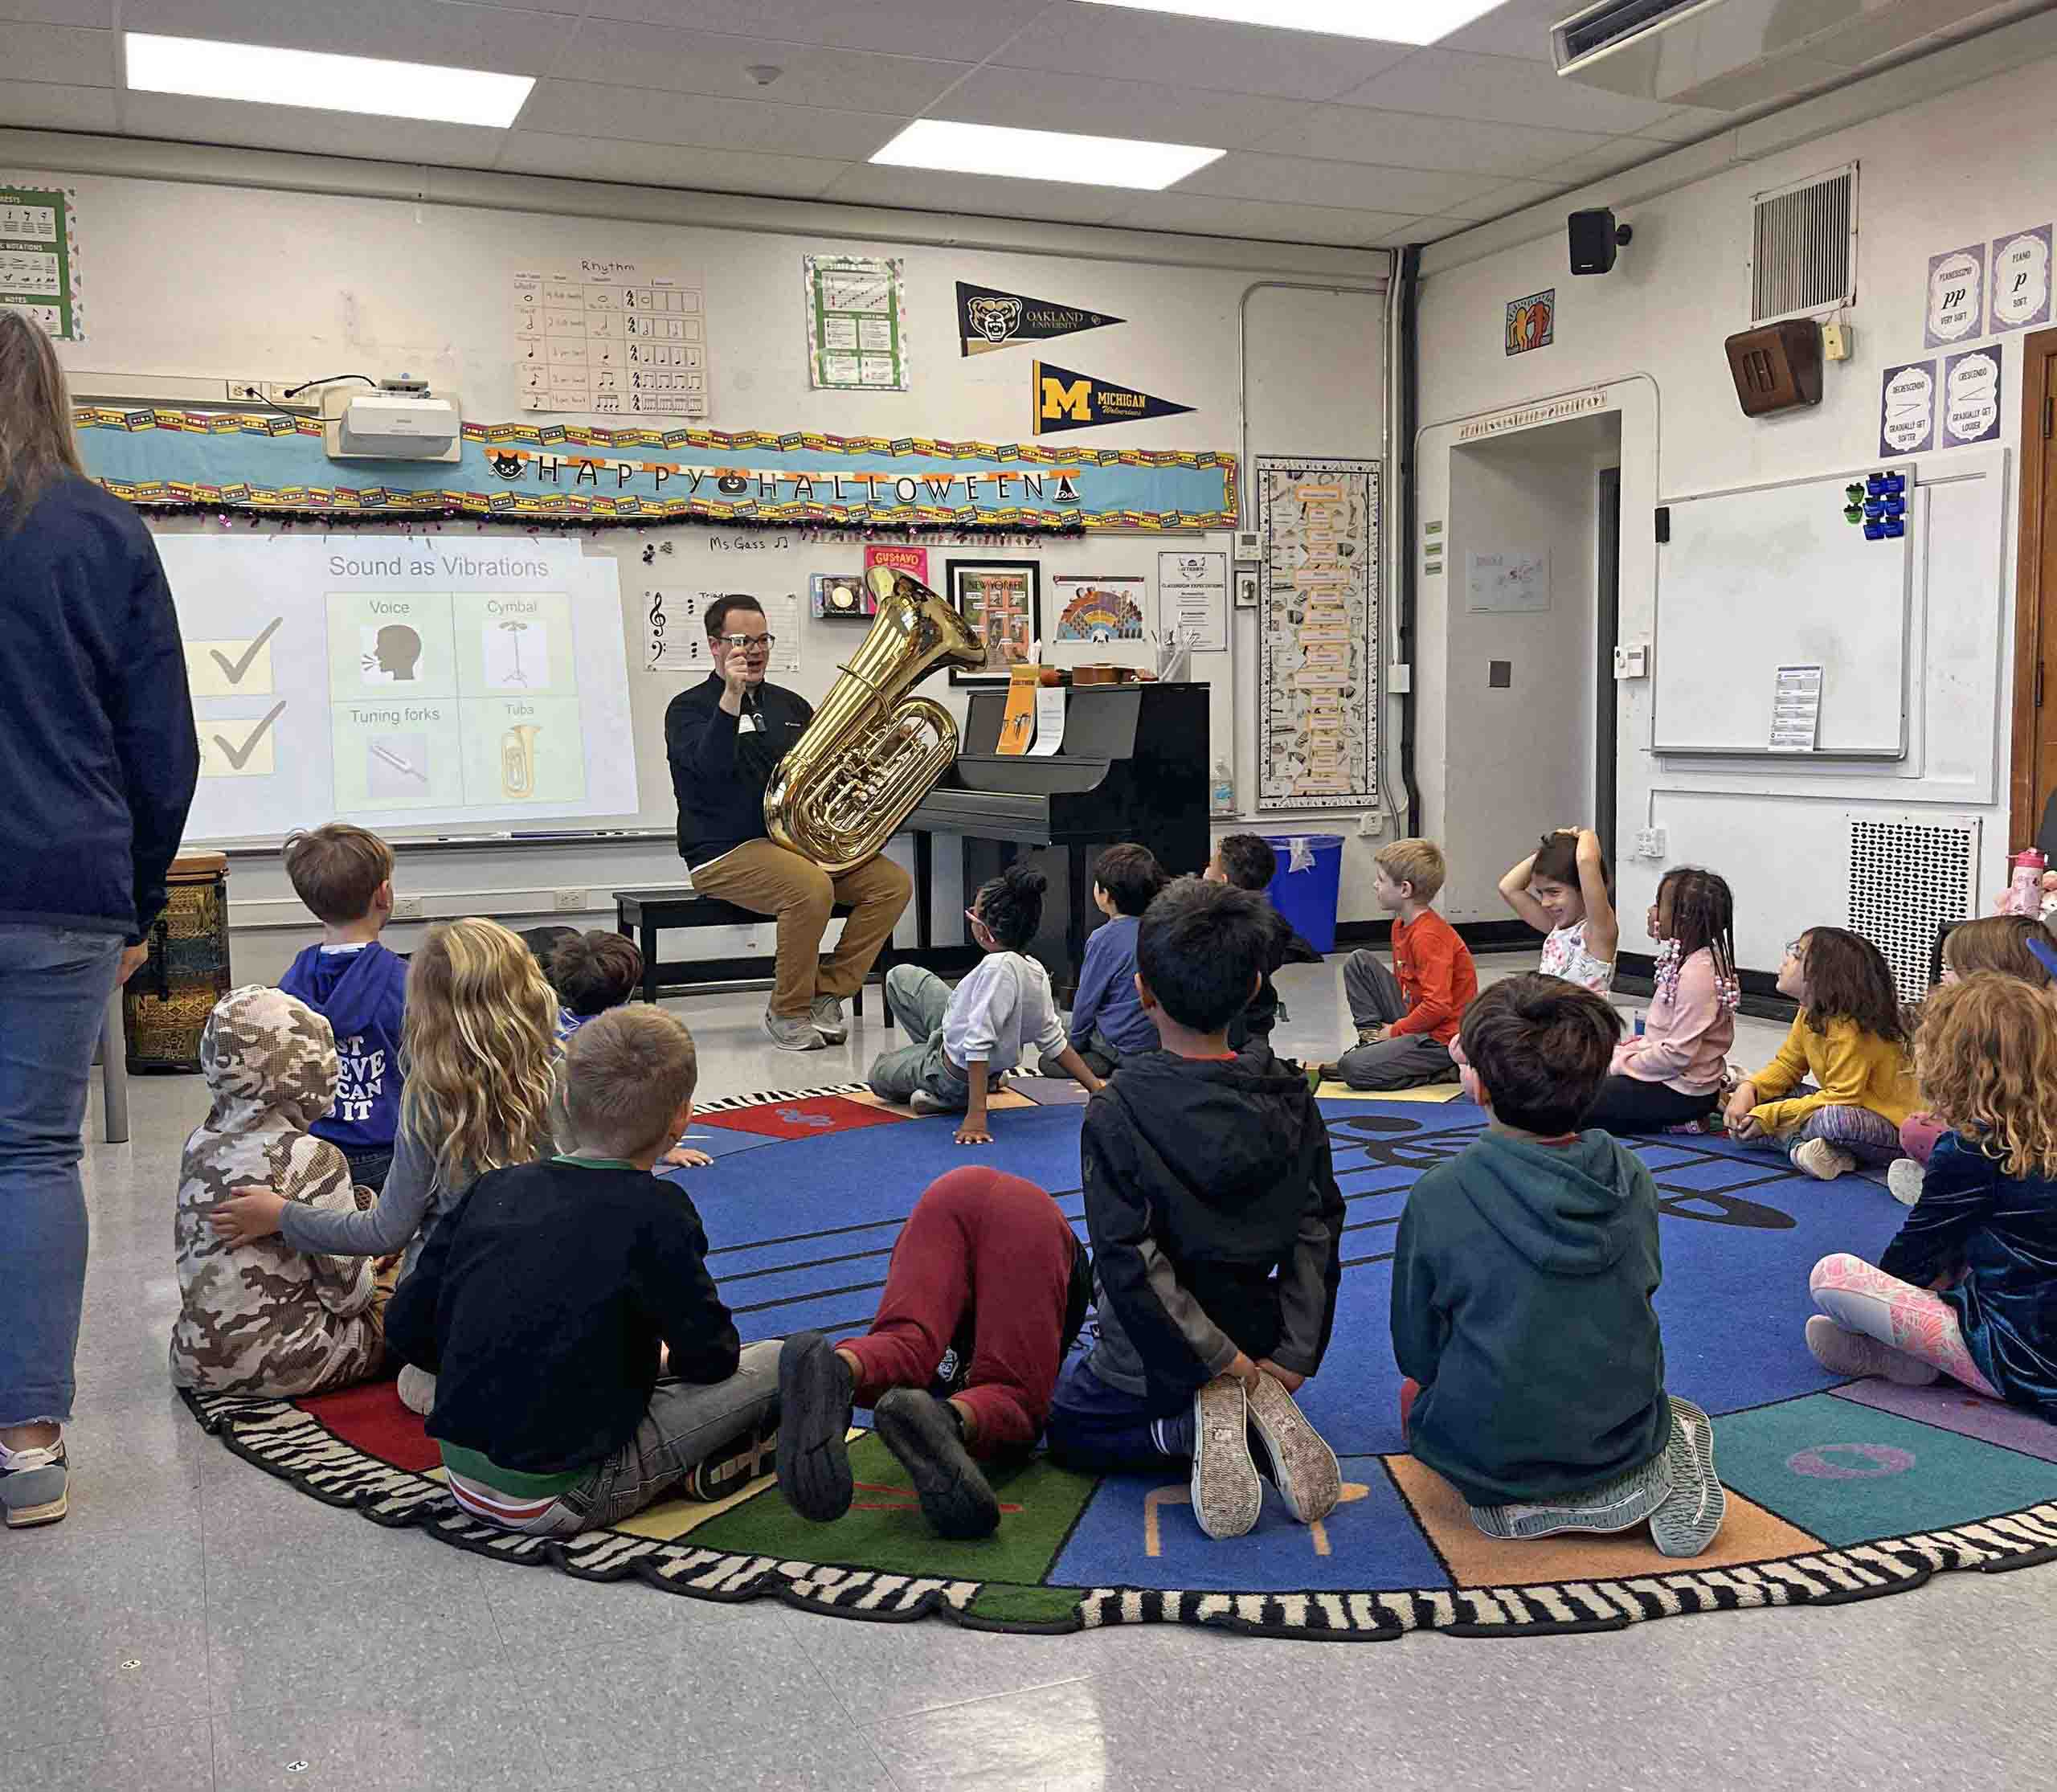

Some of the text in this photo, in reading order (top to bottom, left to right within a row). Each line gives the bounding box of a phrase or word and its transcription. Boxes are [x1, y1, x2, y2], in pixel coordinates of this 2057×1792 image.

[2012, 251, 2030, 263] PIANO
[582, 260, 635, 275] Rhythm
[335, 275, 382, 297] CAN
[2012, 272, 2026, 293] p
[1941, 288, 1966, 309] pp
[2013, 297, 2027, 308] SOFT
[342, 296, 374, 317] IT
[1026, 310, 1083, 322] OAKLAND
[1940, 312, 1968, 325] VERY SOFT
[1959, 367, 1988, 380] CRESCENDO
[1892, 382, 1924, 394] DECRESCENDO
[1041, 378, 1094, 420] M
[1098, 391, 1146, 408] MICHIGAN
[1953, 407, 1991, 421] GRADUALLY GET
[1889, 419, 1925, 432] GRADUALLY GET
[1961, 421, 1981, 432] LOUDER
[538, 455, 1045, 503] HAPPY HALLOWEEN
[734, 536, 765, 550] Gass
[329, 556, 550, 577] Sound as Vibrations
[370, 600, 411, 615] Voice
[487, 599, 538, 614] Cymbal
[352, 707, 440, 725] Tuning forks
[506, 704, 534, 715] Tuba
